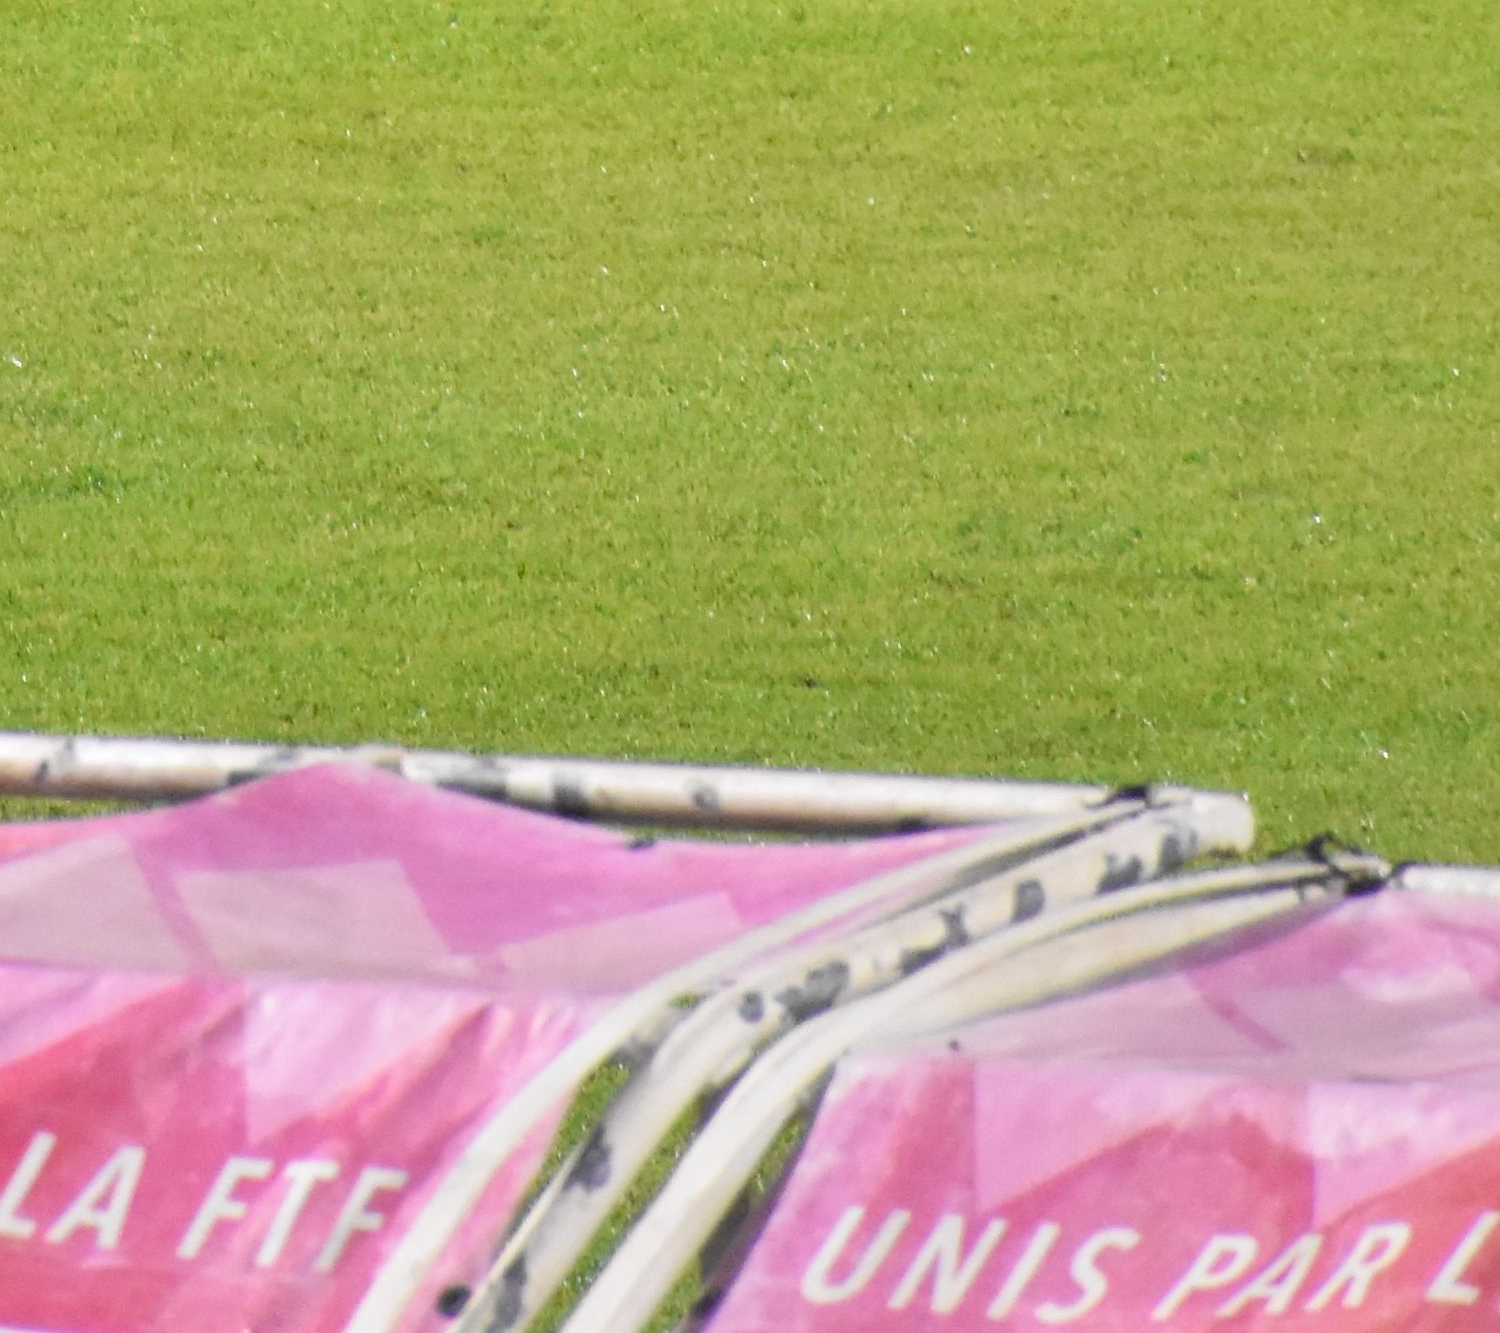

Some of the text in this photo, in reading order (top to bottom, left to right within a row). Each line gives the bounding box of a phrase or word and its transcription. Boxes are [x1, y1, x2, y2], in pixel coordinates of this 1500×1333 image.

[176, 1156, 409, 1274] FTF
[801, 1205, 1140, 1325] UNIS
[1150, 1221, 1414, 1323] PAR
